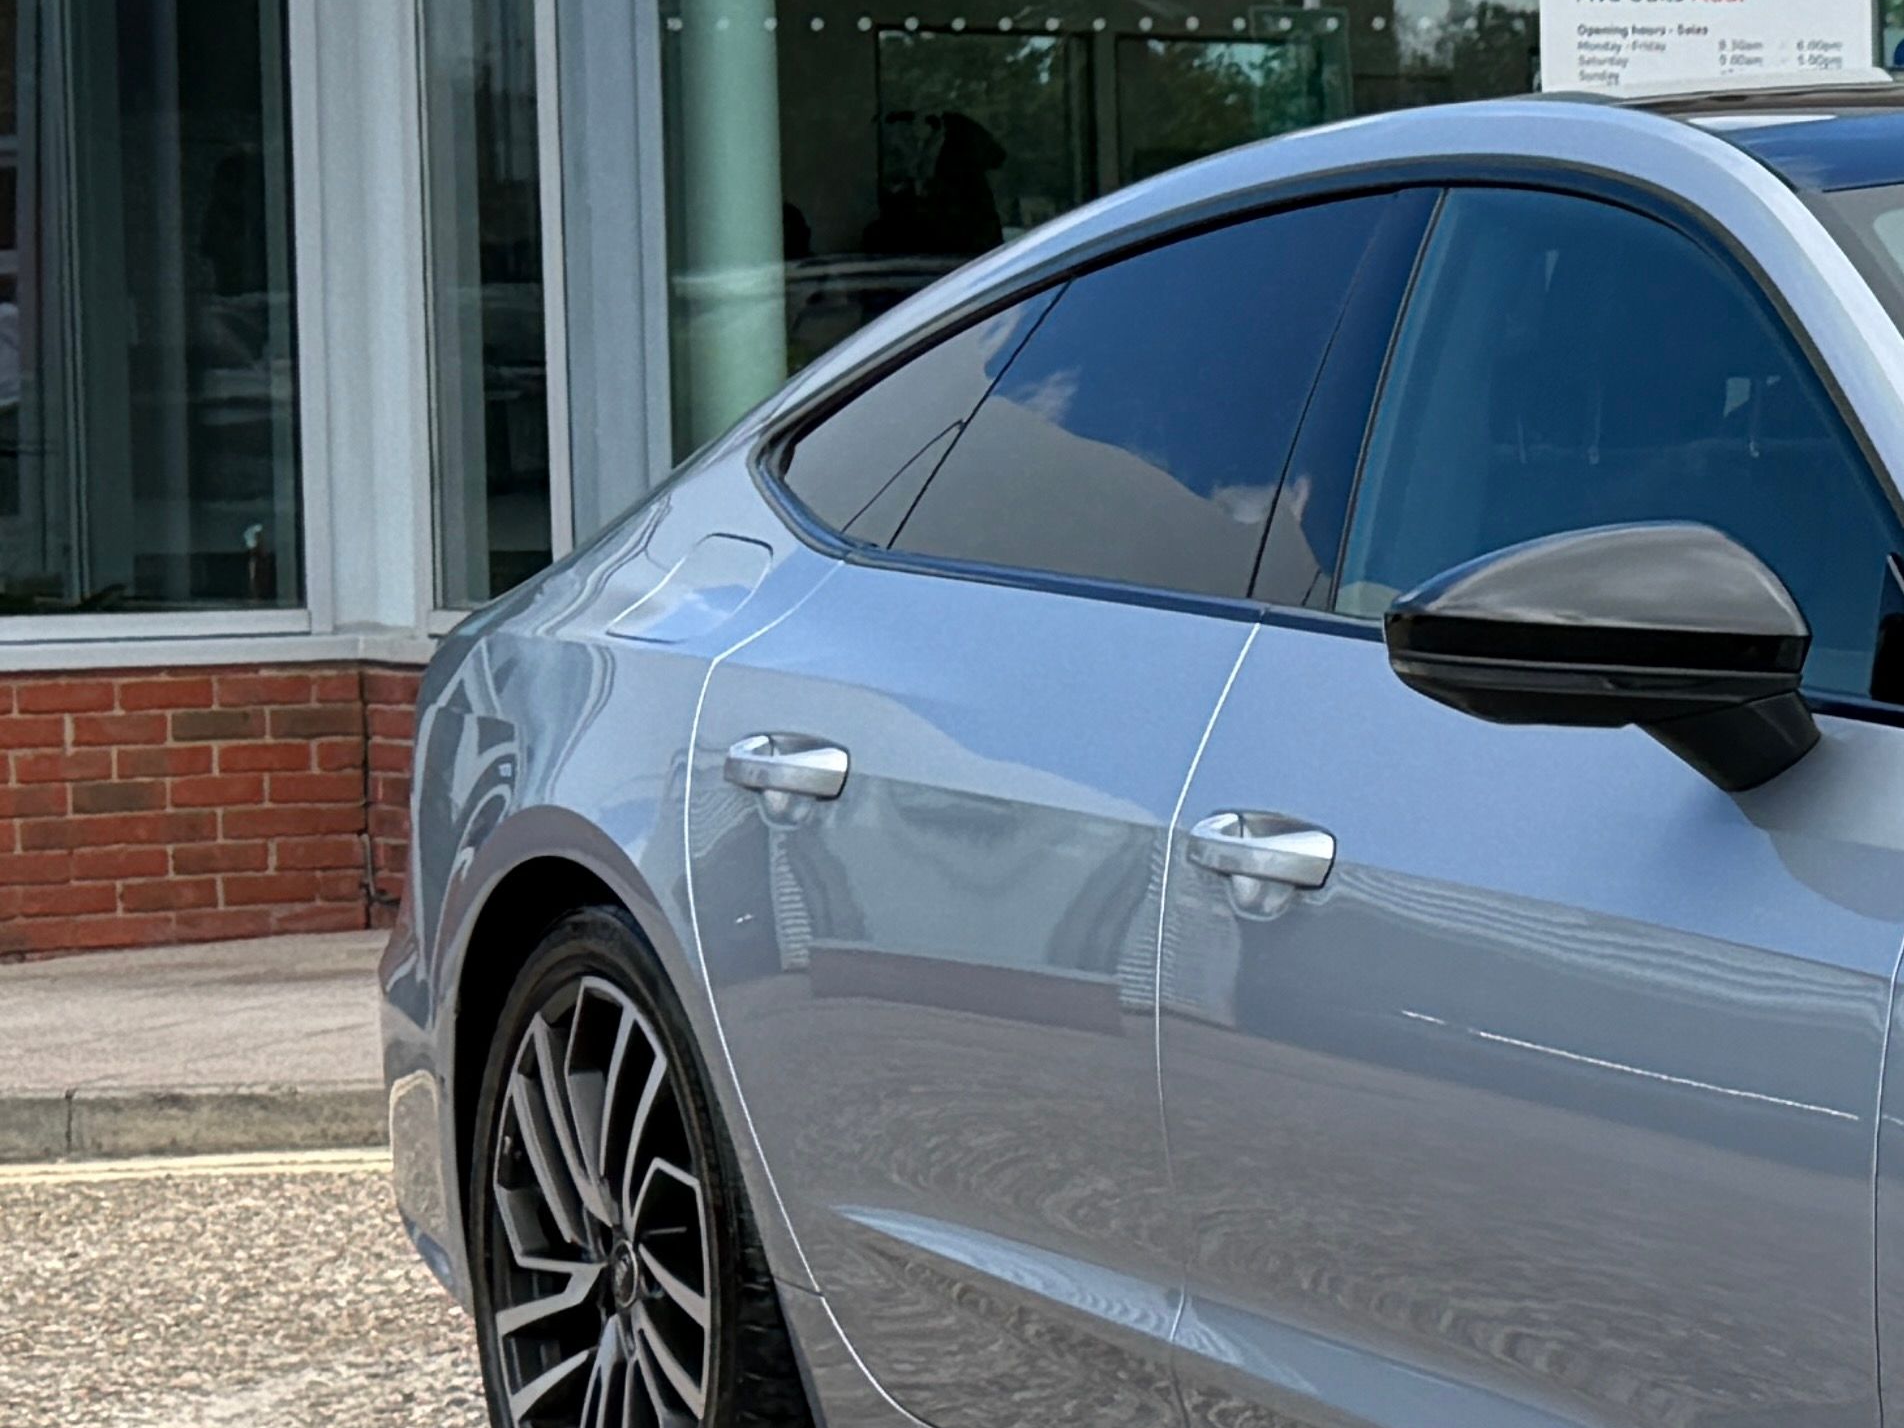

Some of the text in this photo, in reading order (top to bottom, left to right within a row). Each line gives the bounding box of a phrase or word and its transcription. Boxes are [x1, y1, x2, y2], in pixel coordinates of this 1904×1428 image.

[1577, 24, 1628, 38] Opening
[1632, 24, 1666, 35] hours
[1677, 24, 1708, 35] Sales
[1577, 41, 1622, 54] Monday
